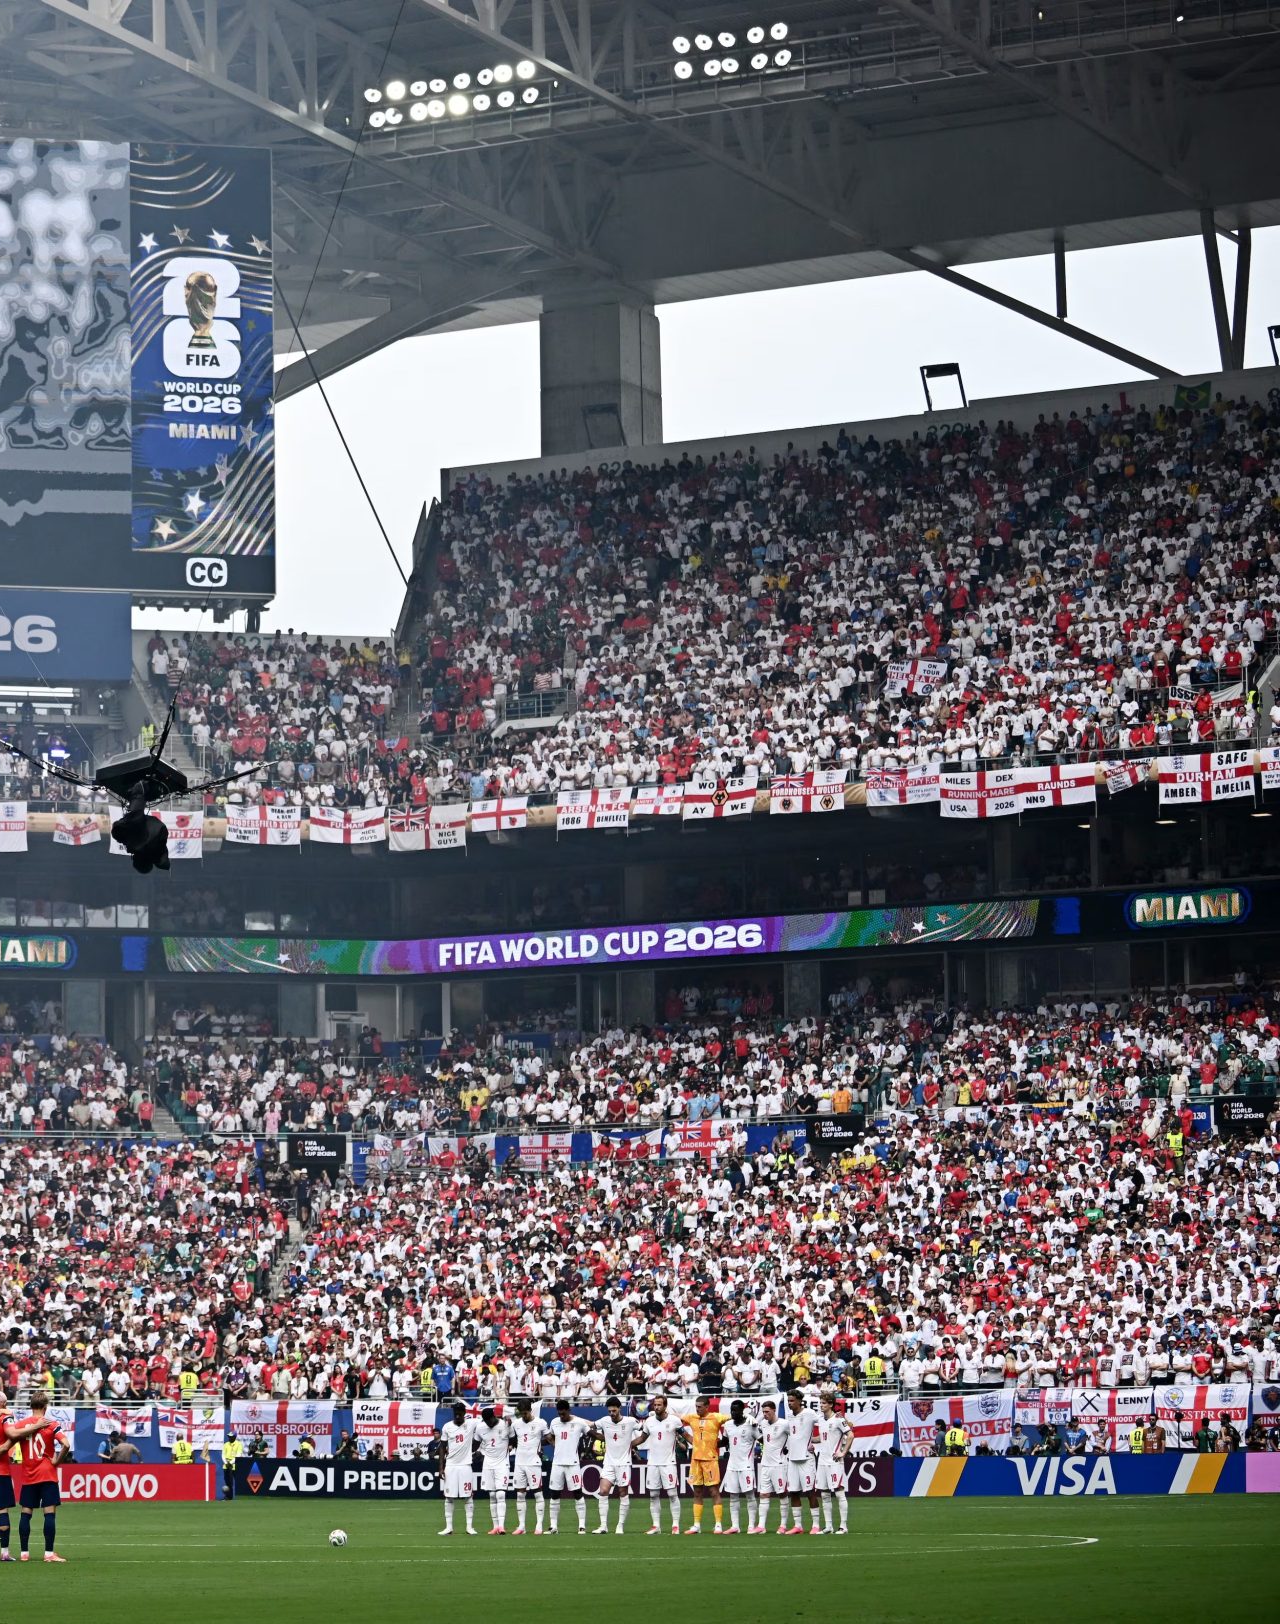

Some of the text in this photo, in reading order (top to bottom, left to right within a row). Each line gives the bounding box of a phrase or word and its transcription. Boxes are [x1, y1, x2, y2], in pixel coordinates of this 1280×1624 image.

[186, 353, 221, 367] FIFA
[163, 381, 242, 395] WORLD CUP
[163, 395, 242, 414] 2026
[169, 423, 237, 440] MIAMI
[190, 562, 223, 583] CC
[1217, 751, 1247, 766] SAFC
[995, 773, 1013, 782] DEX
[1177, 768, 1236, 783] DURHAM
[868, 780, 906, 789] COVENTRY
[907, 778, 924, 786] CITY
[945, 777, 971, 785] MILES
[1037, 780, 1076, 790] RAUNDS
[772, 784, 842, 797] FORDHOUSES WOLVES
[1215, 781, 1251, 795] AMELIA
[948, 789, 987, 799] RUNNING
[989, 787, 1015, 798] MARE
[1164, 787, 1197, 799] AMBER
[1025, 796, 1045, 804] NN9
[560, 802, 625, 813] ARSENAL FC
[730, 802, 747, 811] WE
[950, 804, 967, 812] USA
[994, 801, 1015, 810] 2026
[330, 821, 365, 829] FULHAM
[562, 817, 581, 825] 1886
[404, 823, 435, 832] FULHAM
[187, 829, 200, 838] FC
[1136, 892, 1240, 922] MIAMI
[439, 923, 763, 966] FIFA WORLD CUP 2026
[1193, 1112, 1206, 1120] 130
[794, 1129, 806, 1137] 129
[1117, 1396, 1150, 1405] LENNY
[360, 1404, 380, 1412] Our
[356, 1413, 384, 1422] Mate
[234, 1423, 329, 1435] MIDDLESBROUGH
[355, 1425, 432, 1436] Jimmy Lockett
[994, 1419, 1011, 1433] FC
[455, 1434, 464, 1443] 20
[524, 1434, 528, 1442] 5
[561, 1431, 568, 1440] 10
[613, 1432, 618, 1441] 4
[26, 1432, 46, 1460] 10
[491, 1438, 496, 1447] 2
[269, 1466, 335, 1492] ADI
[532, 1474, 537, 1483] 5
[572, 1474, 580, 1484] 10
[622, 1471, 627, 1480] 4
[668, 1474, 674, 1482] 9
[831, 1473, 838, 1483] 18
[1006, 1456, 1117, 1495] VISA
[58, 1468, 158, 1499] Lenovo
[503, 1476, 508, 1485] 2
[746, 1476, 751, 1485] 6
[806, 1476, 811, 1485] 3
[464, 1482, 472, 1491] 20
